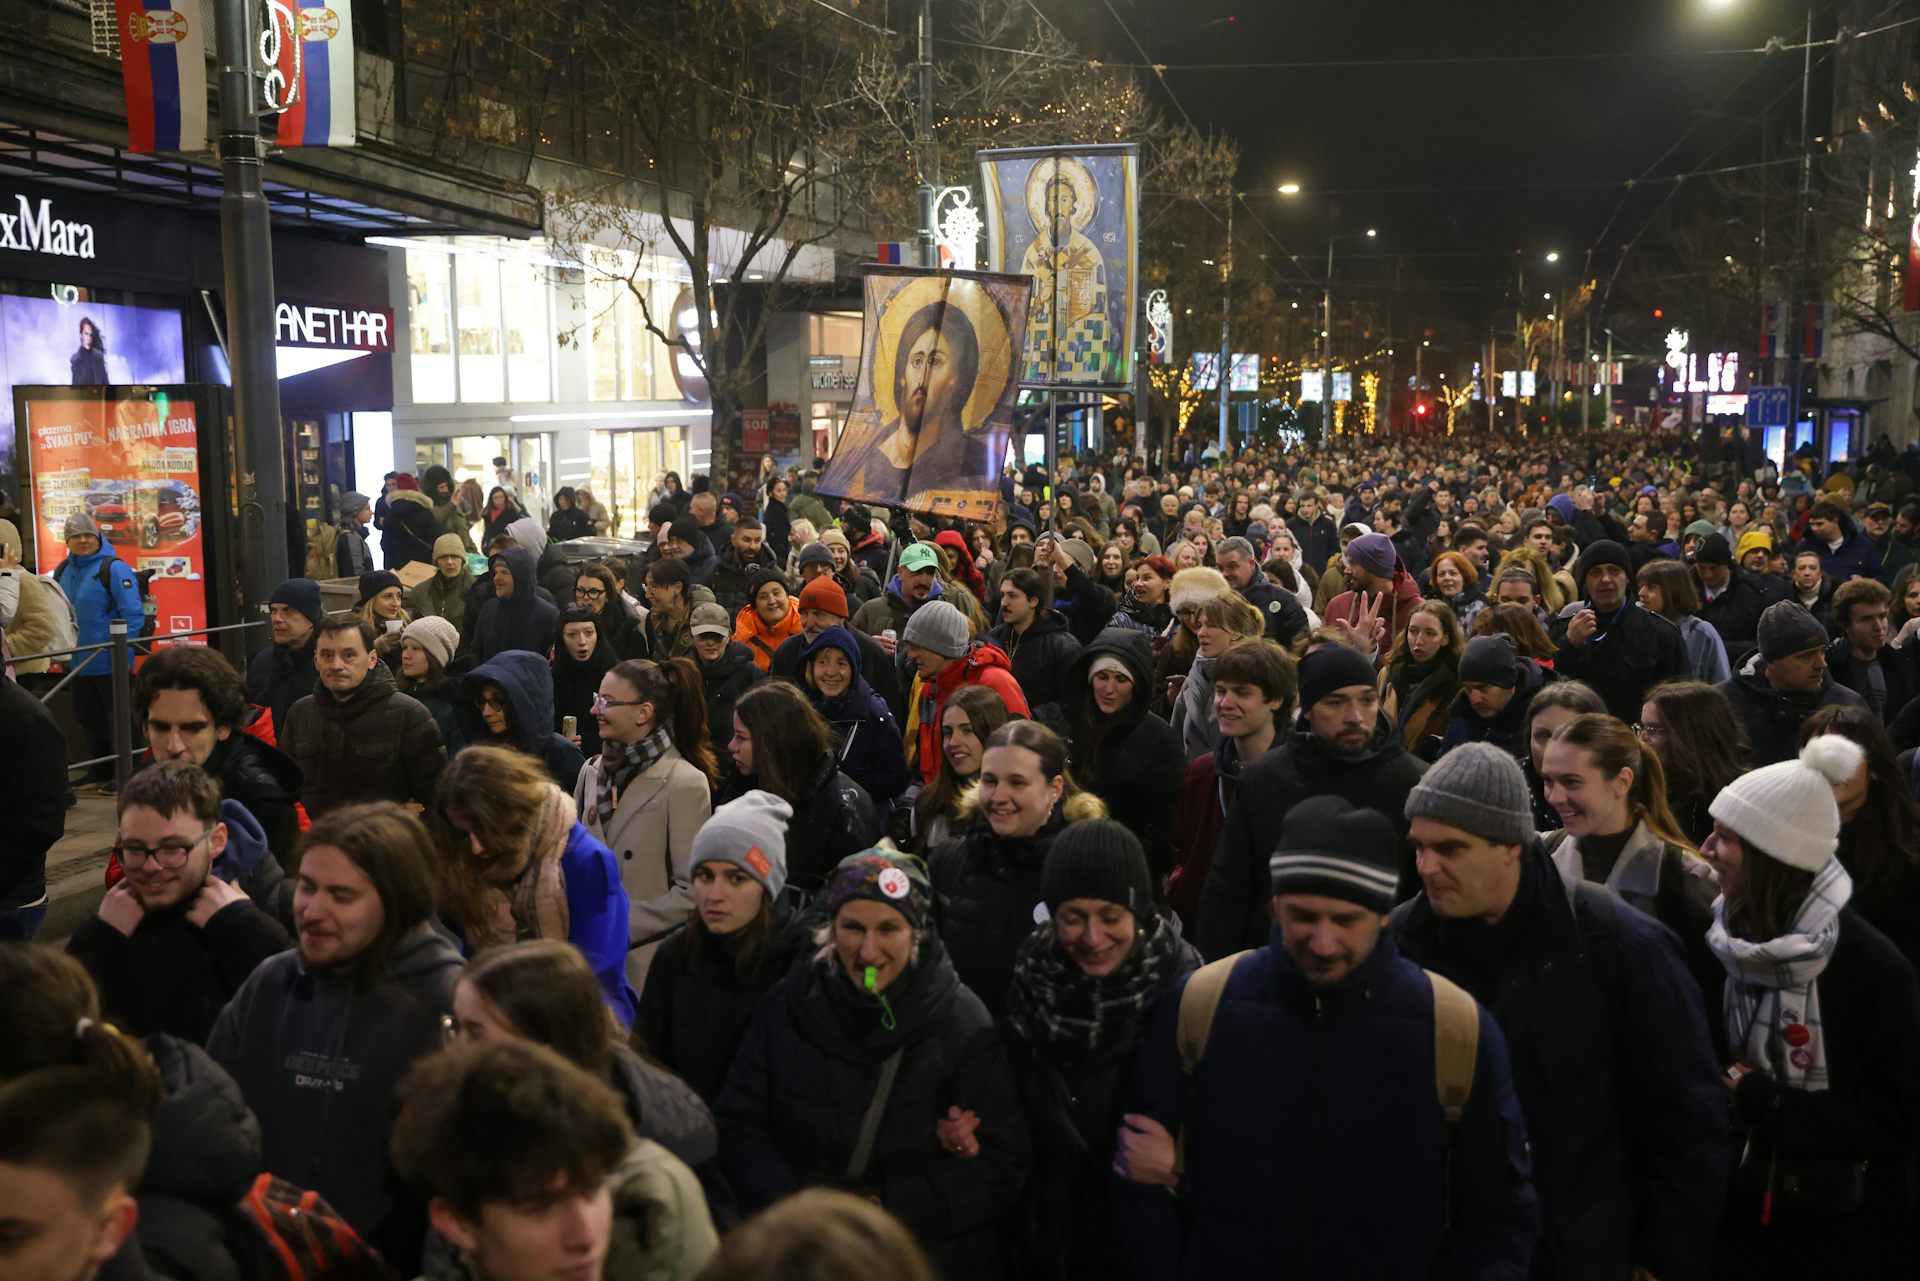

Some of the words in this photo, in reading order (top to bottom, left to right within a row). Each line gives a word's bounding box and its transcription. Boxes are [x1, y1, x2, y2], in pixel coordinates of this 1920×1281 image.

[275, 302, 340, 344] ANET
[38, 425, 72, 438] plazma
[107, 421, 168, 441] NAGRADNA
[168, 417, 197, 435] IGRA
[166, 460, 193, 471] KODIAQ
